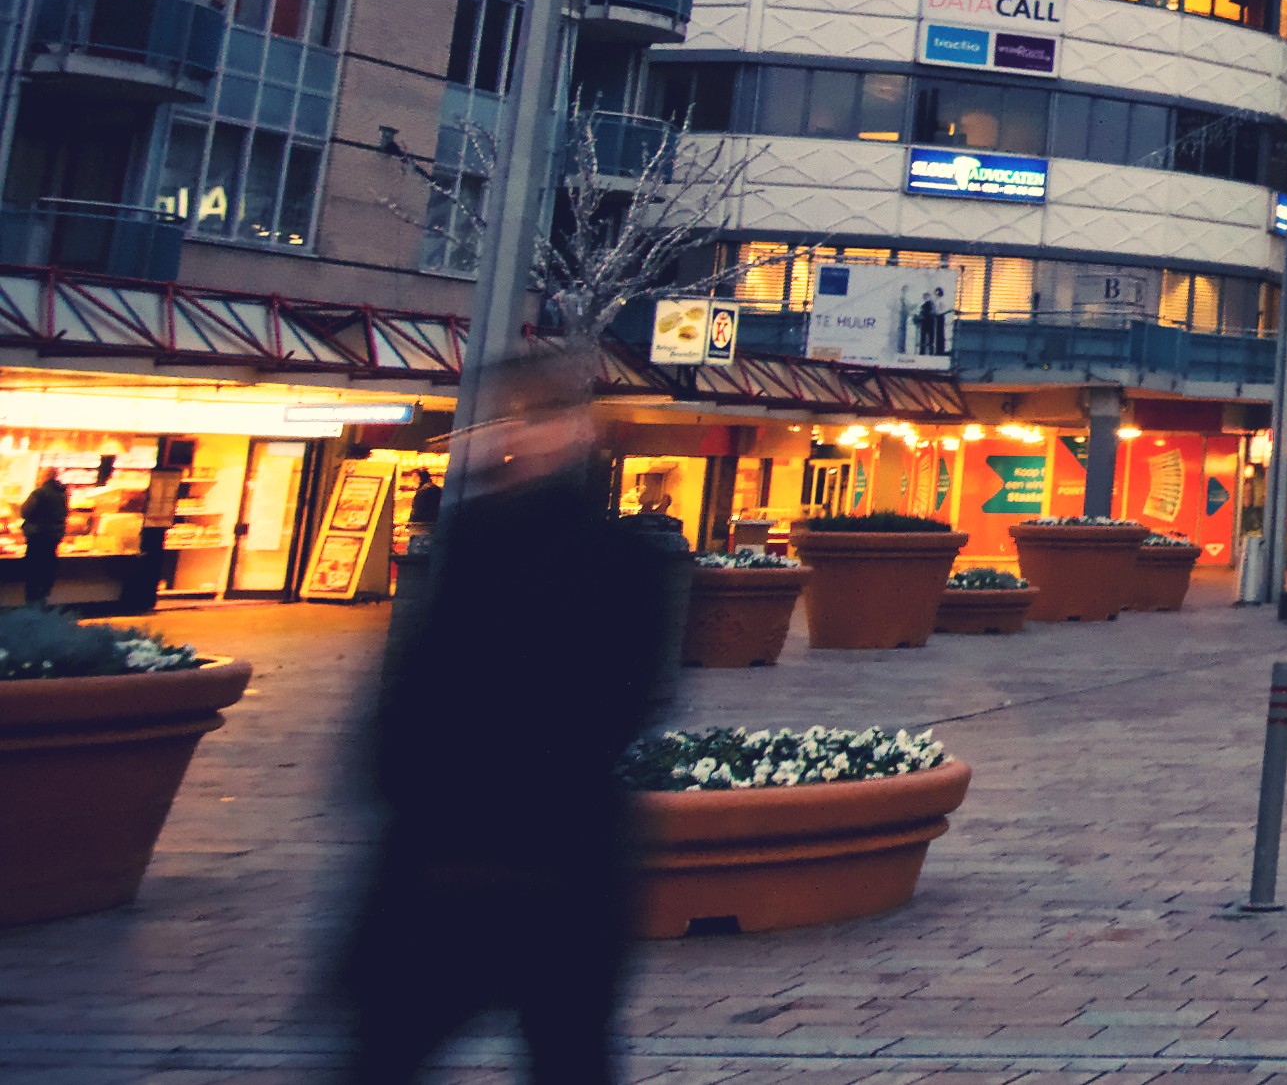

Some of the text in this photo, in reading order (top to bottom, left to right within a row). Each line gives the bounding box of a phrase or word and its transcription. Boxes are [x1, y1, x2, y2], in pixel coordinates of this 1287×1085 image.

[969, 166, 1046, 186] ADVOCATEN
[1104, 276, 1120, 299] B
[714, 321, 729, 342] K
